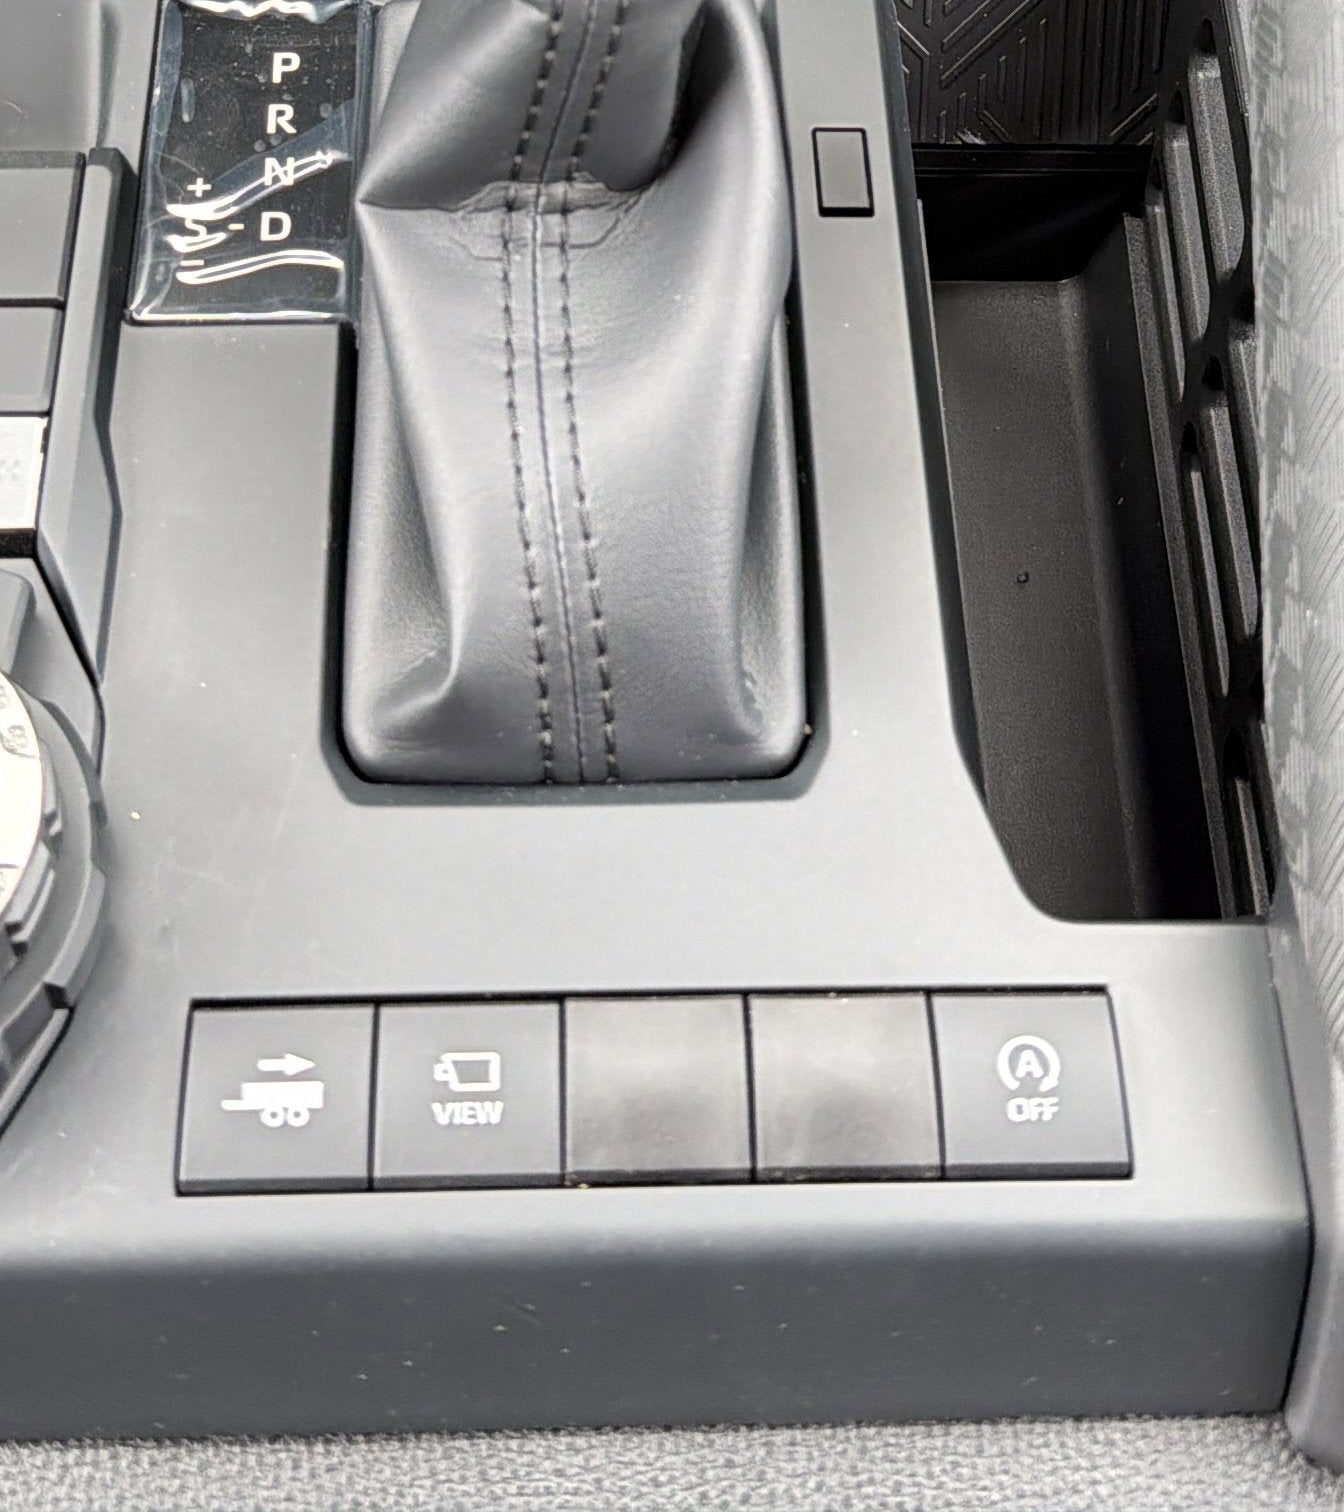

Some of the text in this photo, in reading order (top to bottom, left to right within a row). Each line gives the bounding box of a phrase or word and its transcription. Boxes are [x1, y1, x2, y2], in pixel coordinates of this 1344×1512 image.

[273, 53, 300, 83] P
[267, 104, 297, 134] R
[264, 157, 295, 186] N
[260, 212, 291, 241] D
[431, 1100, 504, 1125] VIEW
[1006, 1096, 1060, 1122] OFF
